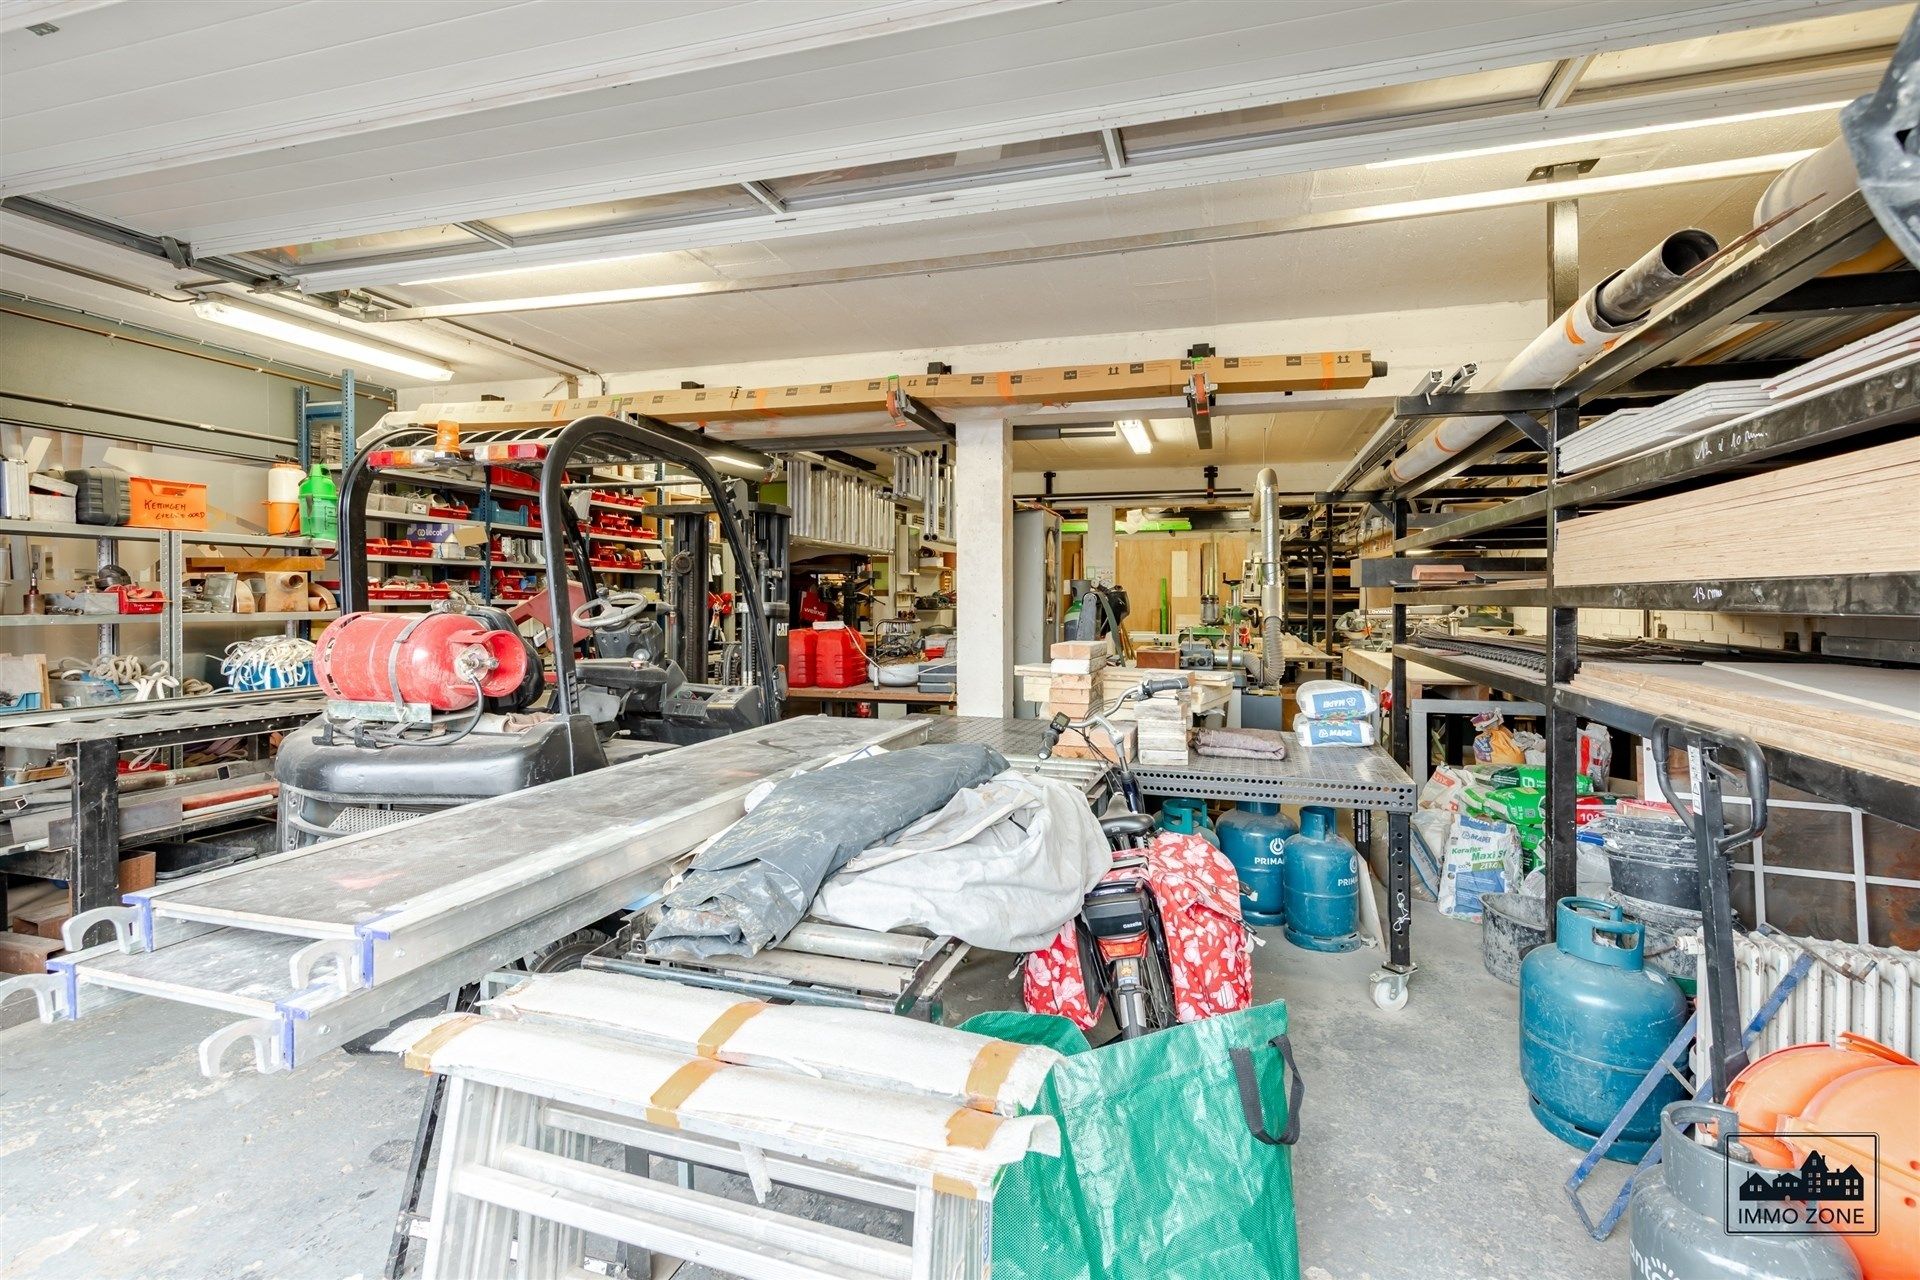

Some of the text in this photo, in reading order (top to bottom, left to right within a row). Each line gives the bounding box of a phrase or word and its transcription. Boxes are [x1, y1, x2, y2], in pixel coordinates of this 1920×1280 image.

[1692, 586, 1706, 604] 18
[776, 622, 789, 637] CAT
[1323, 699, 1346, 709] MAPEI
[1329, 729, 1353, 737] MAPEI
[1470, 832, 1492, 844] MAPEI
[1254, 856, 1285, 866] PRIMA
[1471, 851, 1496, 861] Maxi
